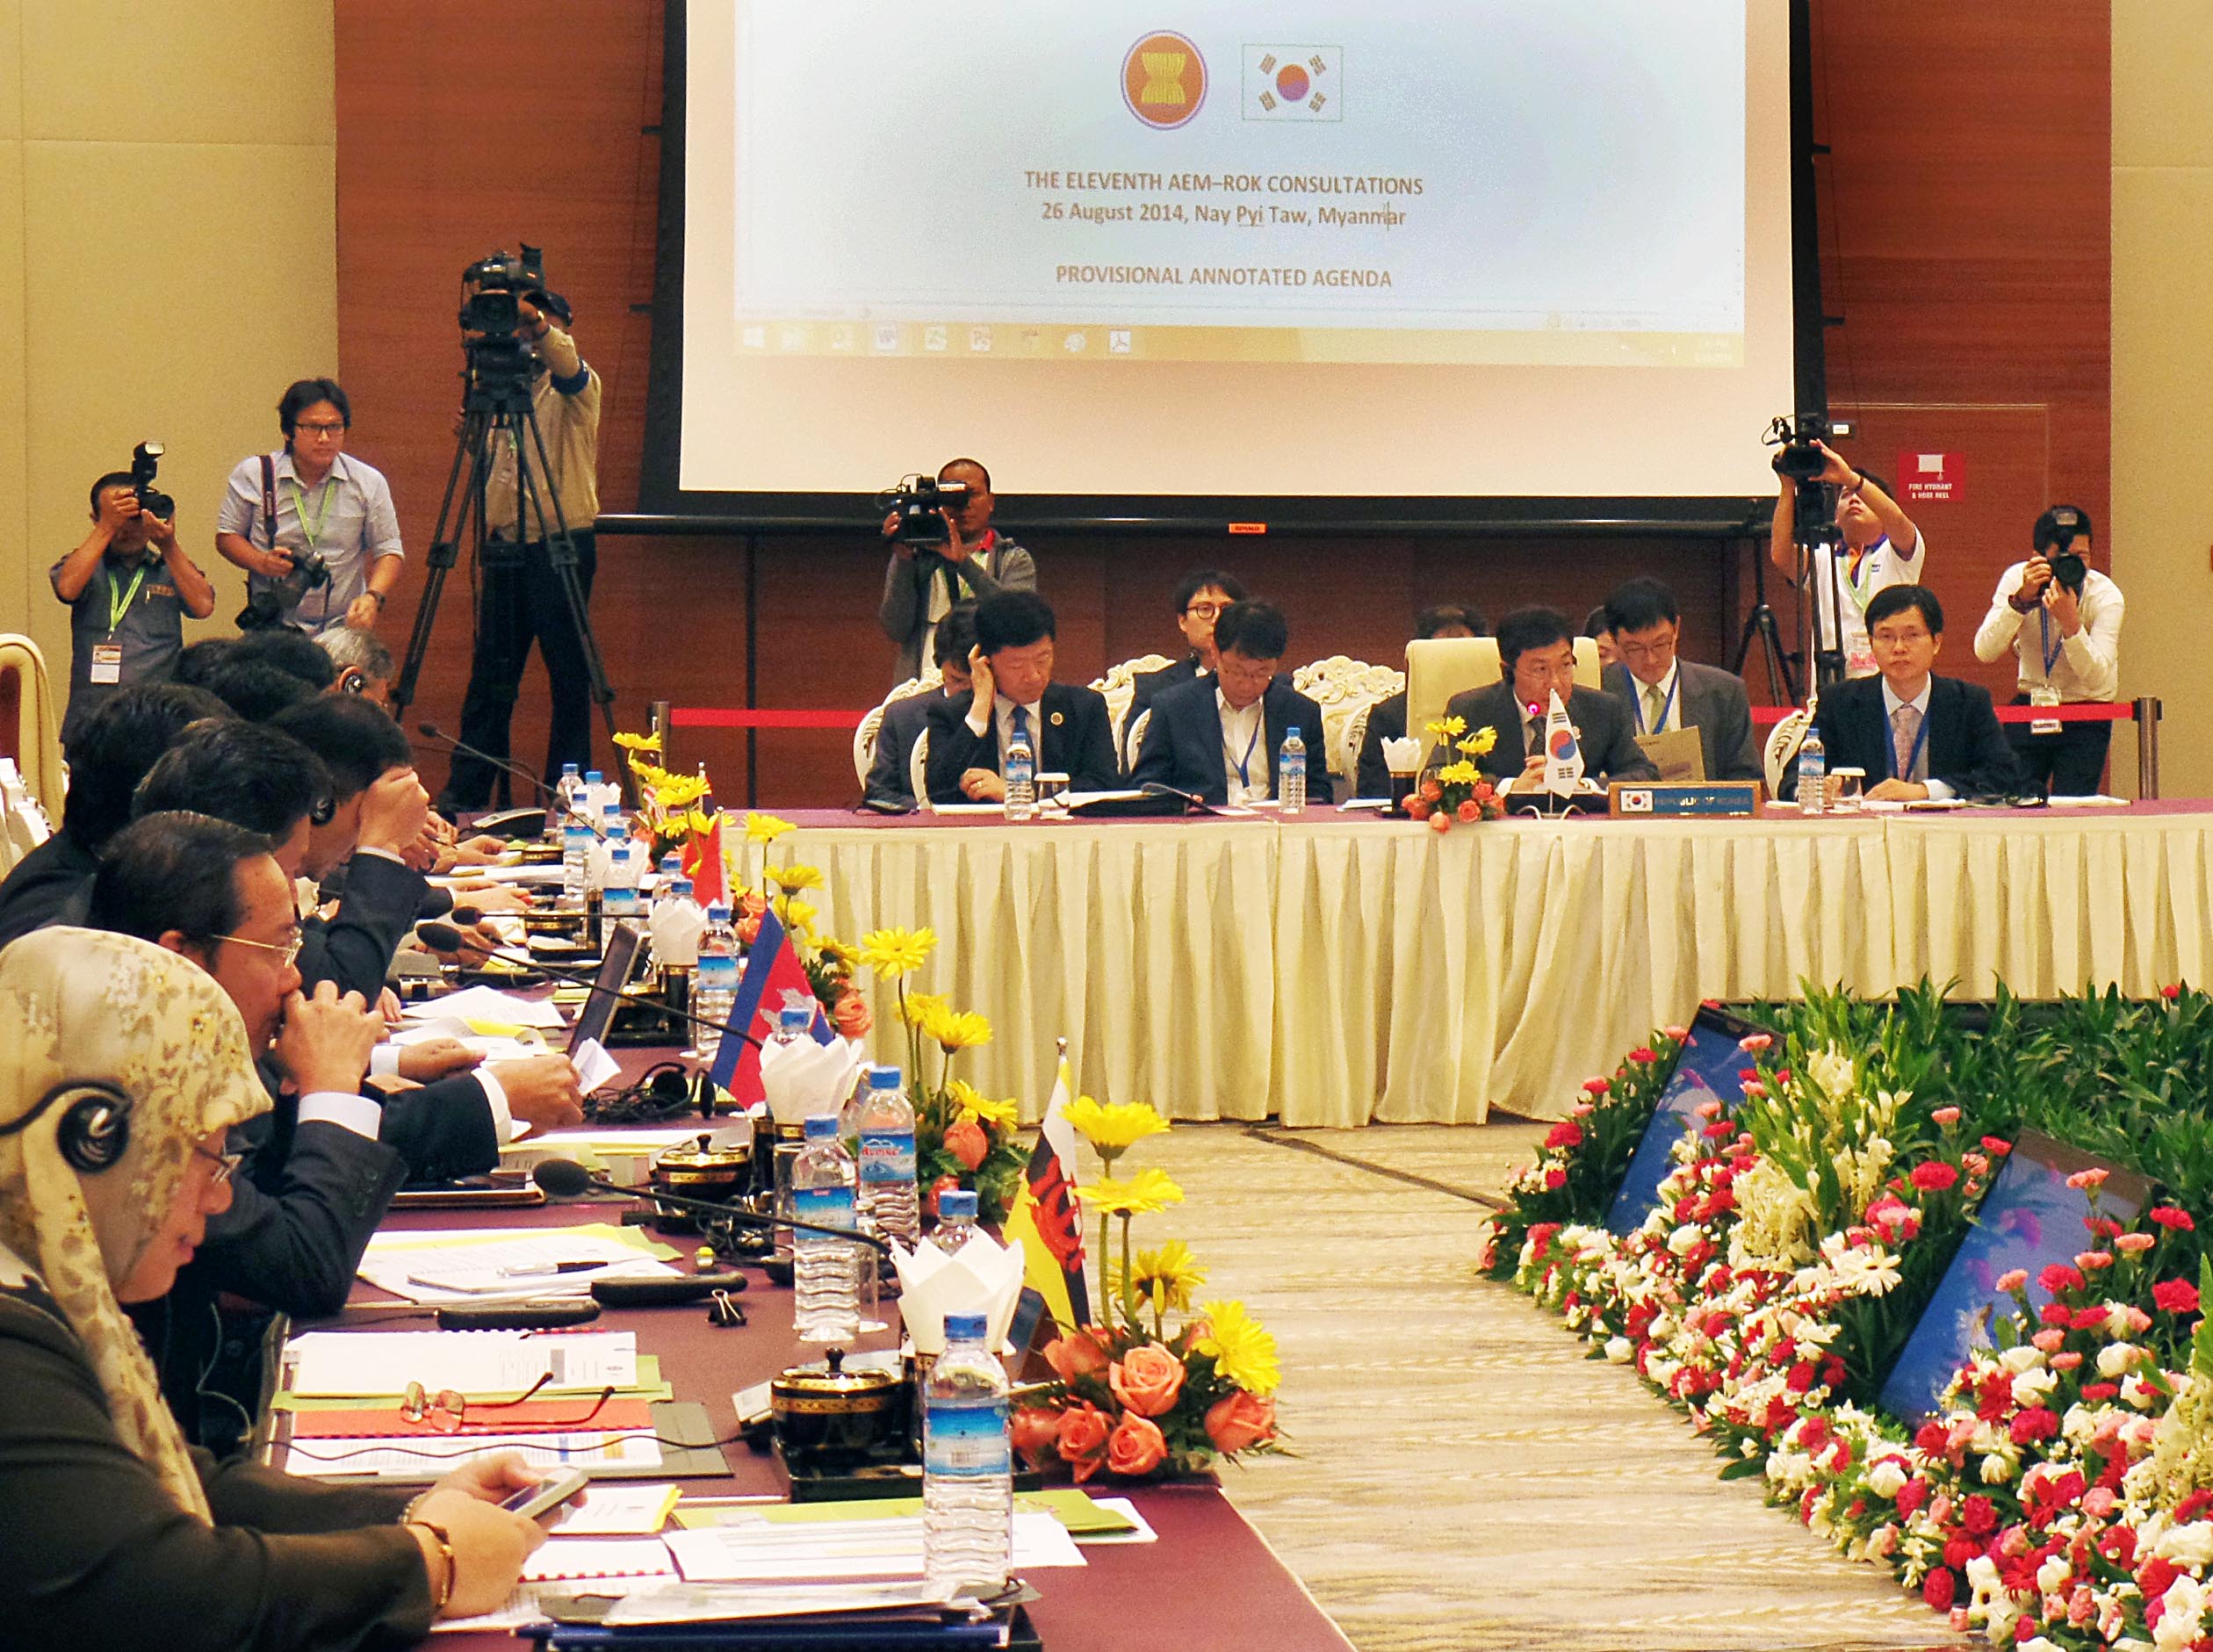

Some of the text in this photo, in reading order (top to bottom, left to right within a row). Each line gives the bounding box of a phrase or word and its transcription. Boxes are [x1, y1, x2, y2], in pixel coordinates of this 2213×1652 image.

[1025, 170, 1060, 189] THE
[1065, 171, 1162, 191] ELEVENTH
[1267, 176, 1424, 195] CONSULTATIONS
[1042, 202, 1406, 227] 26 August 2014, Nay Pyi Taw, Myanmar
[1056, 265, 1393, 287] PROVISIONAL ANNOTATED AGENDA
